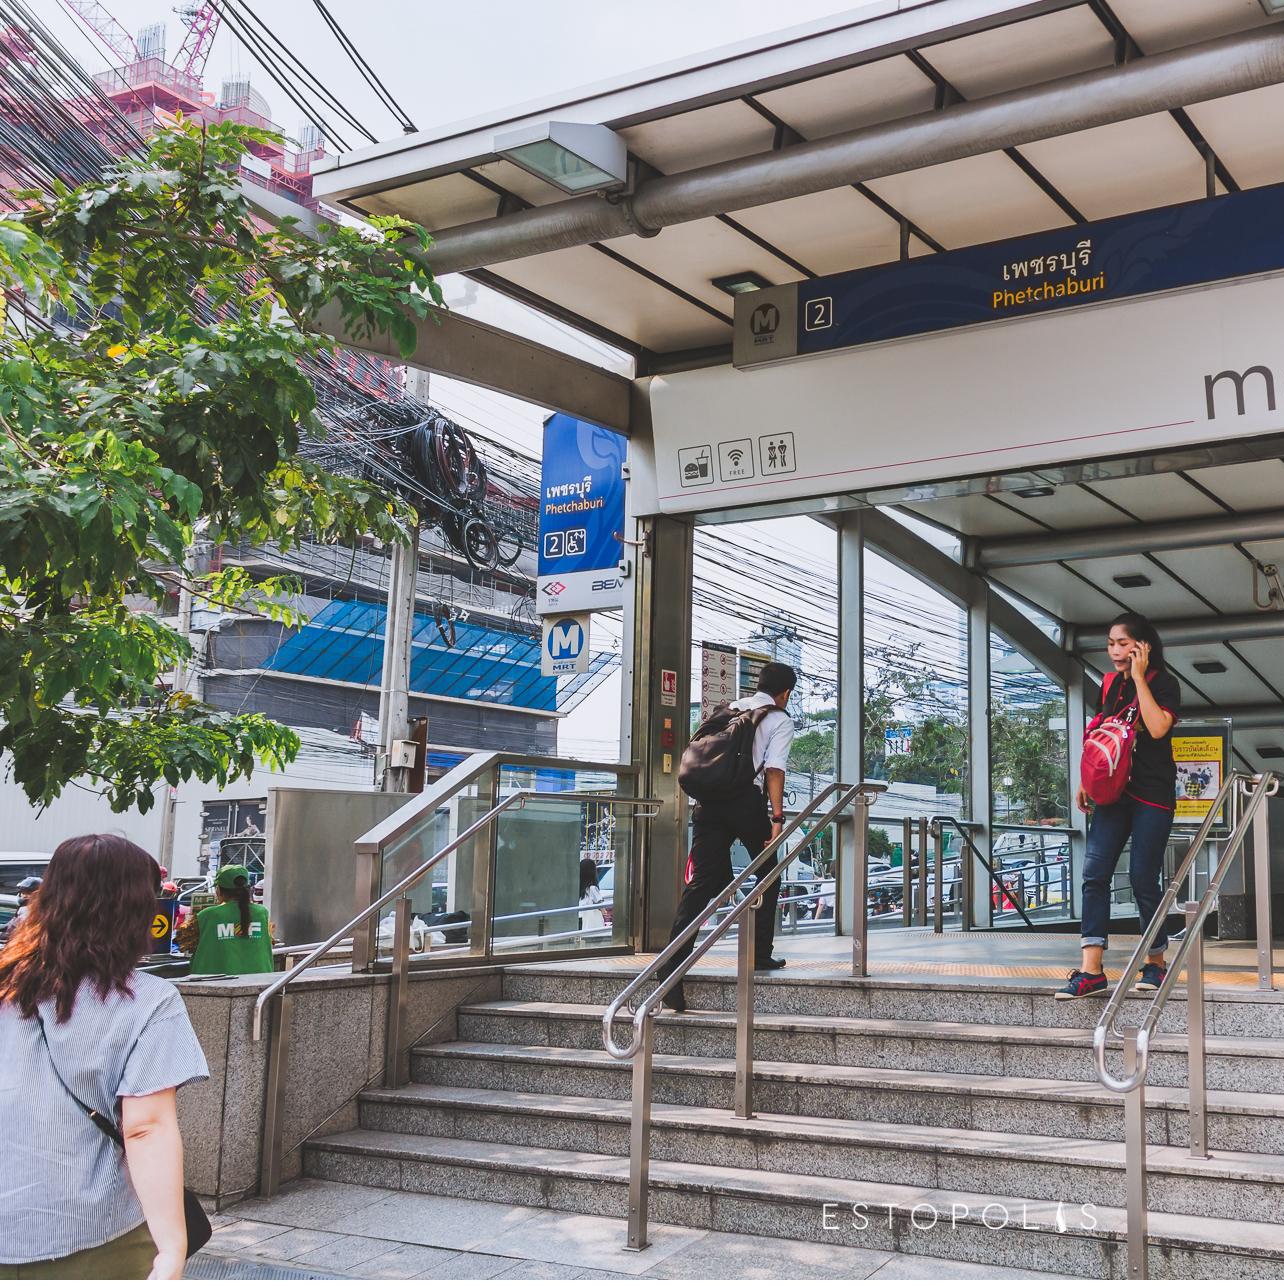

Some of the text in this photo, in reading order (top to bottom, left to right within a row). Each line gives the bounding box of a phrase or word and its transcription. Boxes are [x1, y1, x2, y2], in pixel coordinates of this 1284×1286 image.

[1003, 239, 1092, 280] เพชรบุรี
[993, 271, 1104, 308] Phetchaburi
[814, 304, 825, 325] 2
[729, 468, 745, 477] FREE
[546, 475, 592, 499] เพชรบุรี
[545, 496, 604, 515] Phetchaburi
[549, 536, 559, 553] 2
[552, 663, 576, 671] MRT
